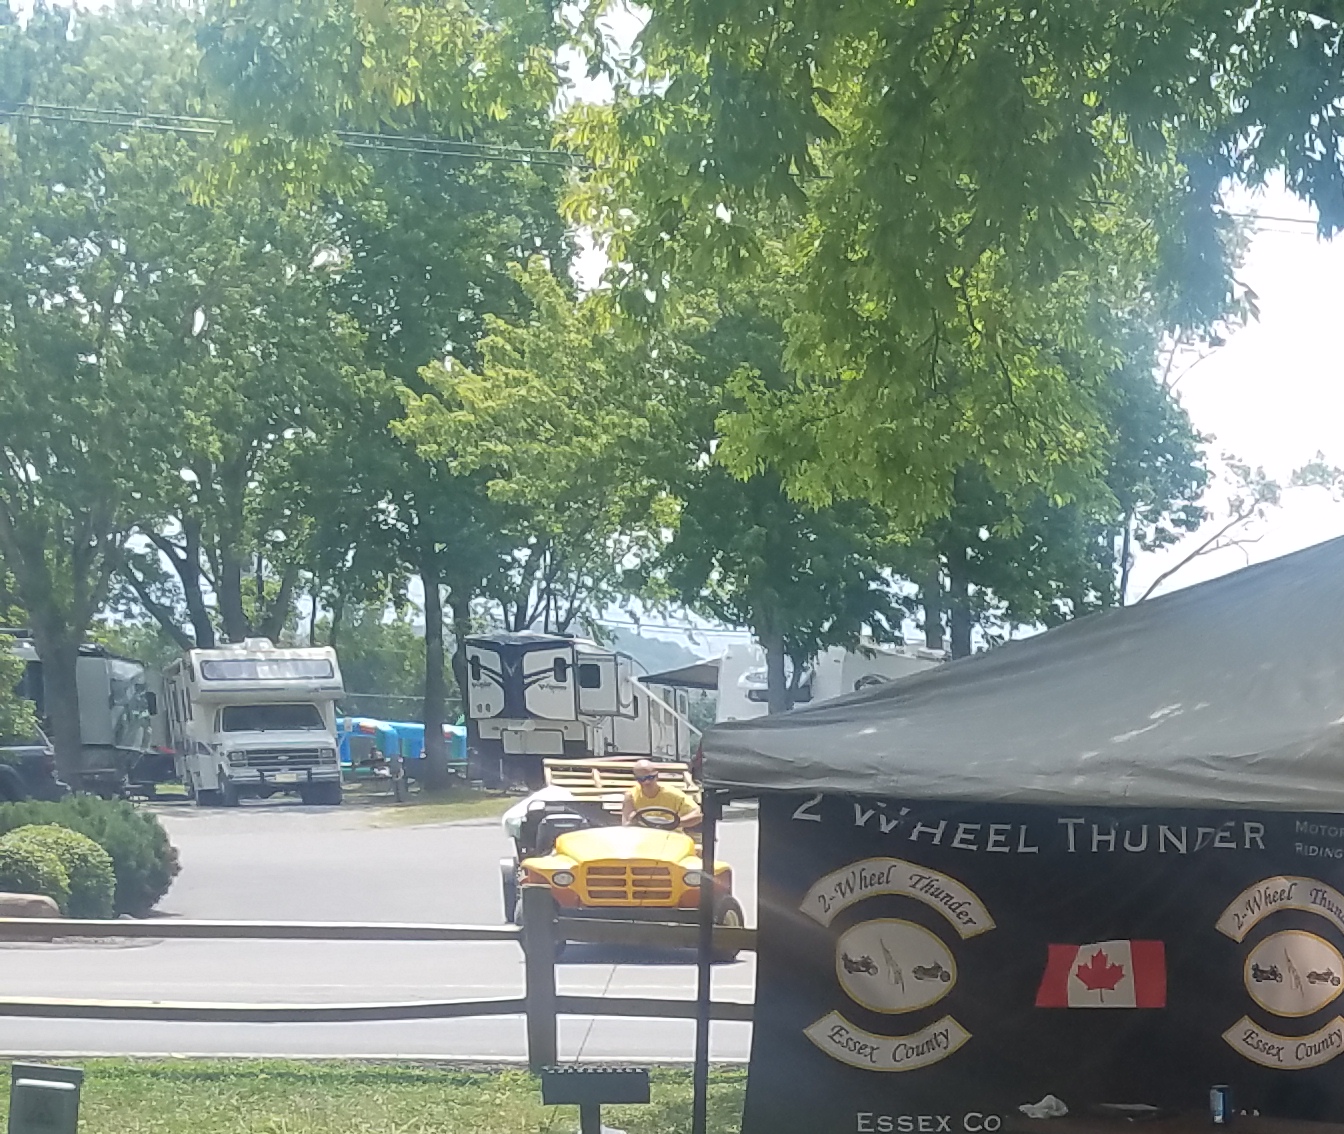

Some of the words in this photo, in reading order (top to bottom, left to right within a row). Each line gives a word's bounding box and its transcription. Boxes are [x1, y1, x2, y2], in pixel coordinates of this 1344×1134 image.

[1057, 817, 1266, 854] THUNDER
[908, 873, 977, 927] Thunder
[827, 1025, 881, 1063] Essex
[891, 1028, 950, 1063] County
[1242, 1028, 1285, 1062] Essex
[1295, 1028, 1344, 1062] County
[856, 1112, 952, 1133] ESSEX
